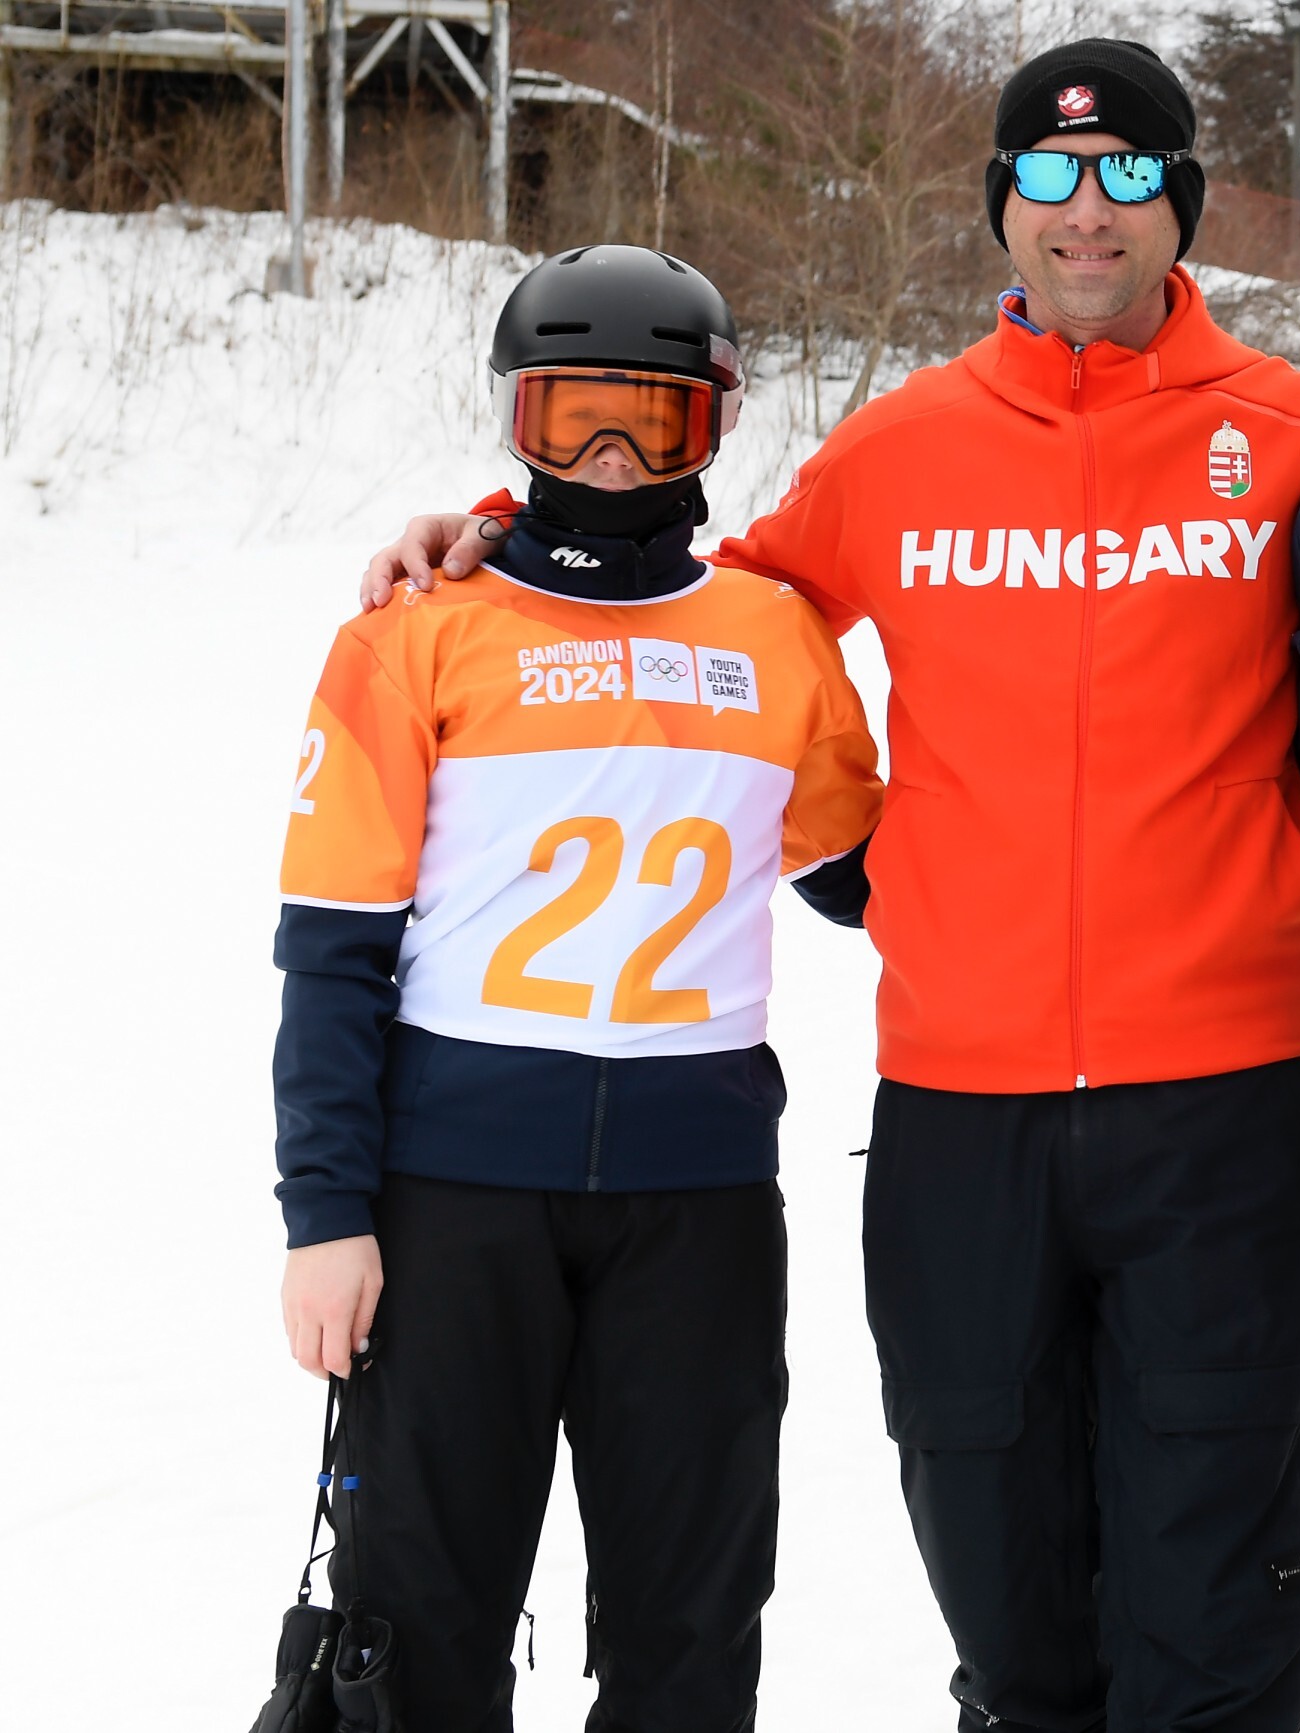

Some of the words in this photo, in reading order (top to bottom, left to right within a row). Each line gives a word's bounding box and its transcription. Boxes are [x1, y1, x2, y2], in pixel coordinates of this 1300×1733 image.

[900, 518, 1278, 591] HUNGARY
[517, 639, 623, 668] GANGWON
[709, 658, 742, 673] YOUTH
[519, 664, 626, 706] 2024
[706, 671, 750, 688] OLYMPIC
[712, 684, 748, 700] GAMES
[481, 815, 732, 1024] 22
